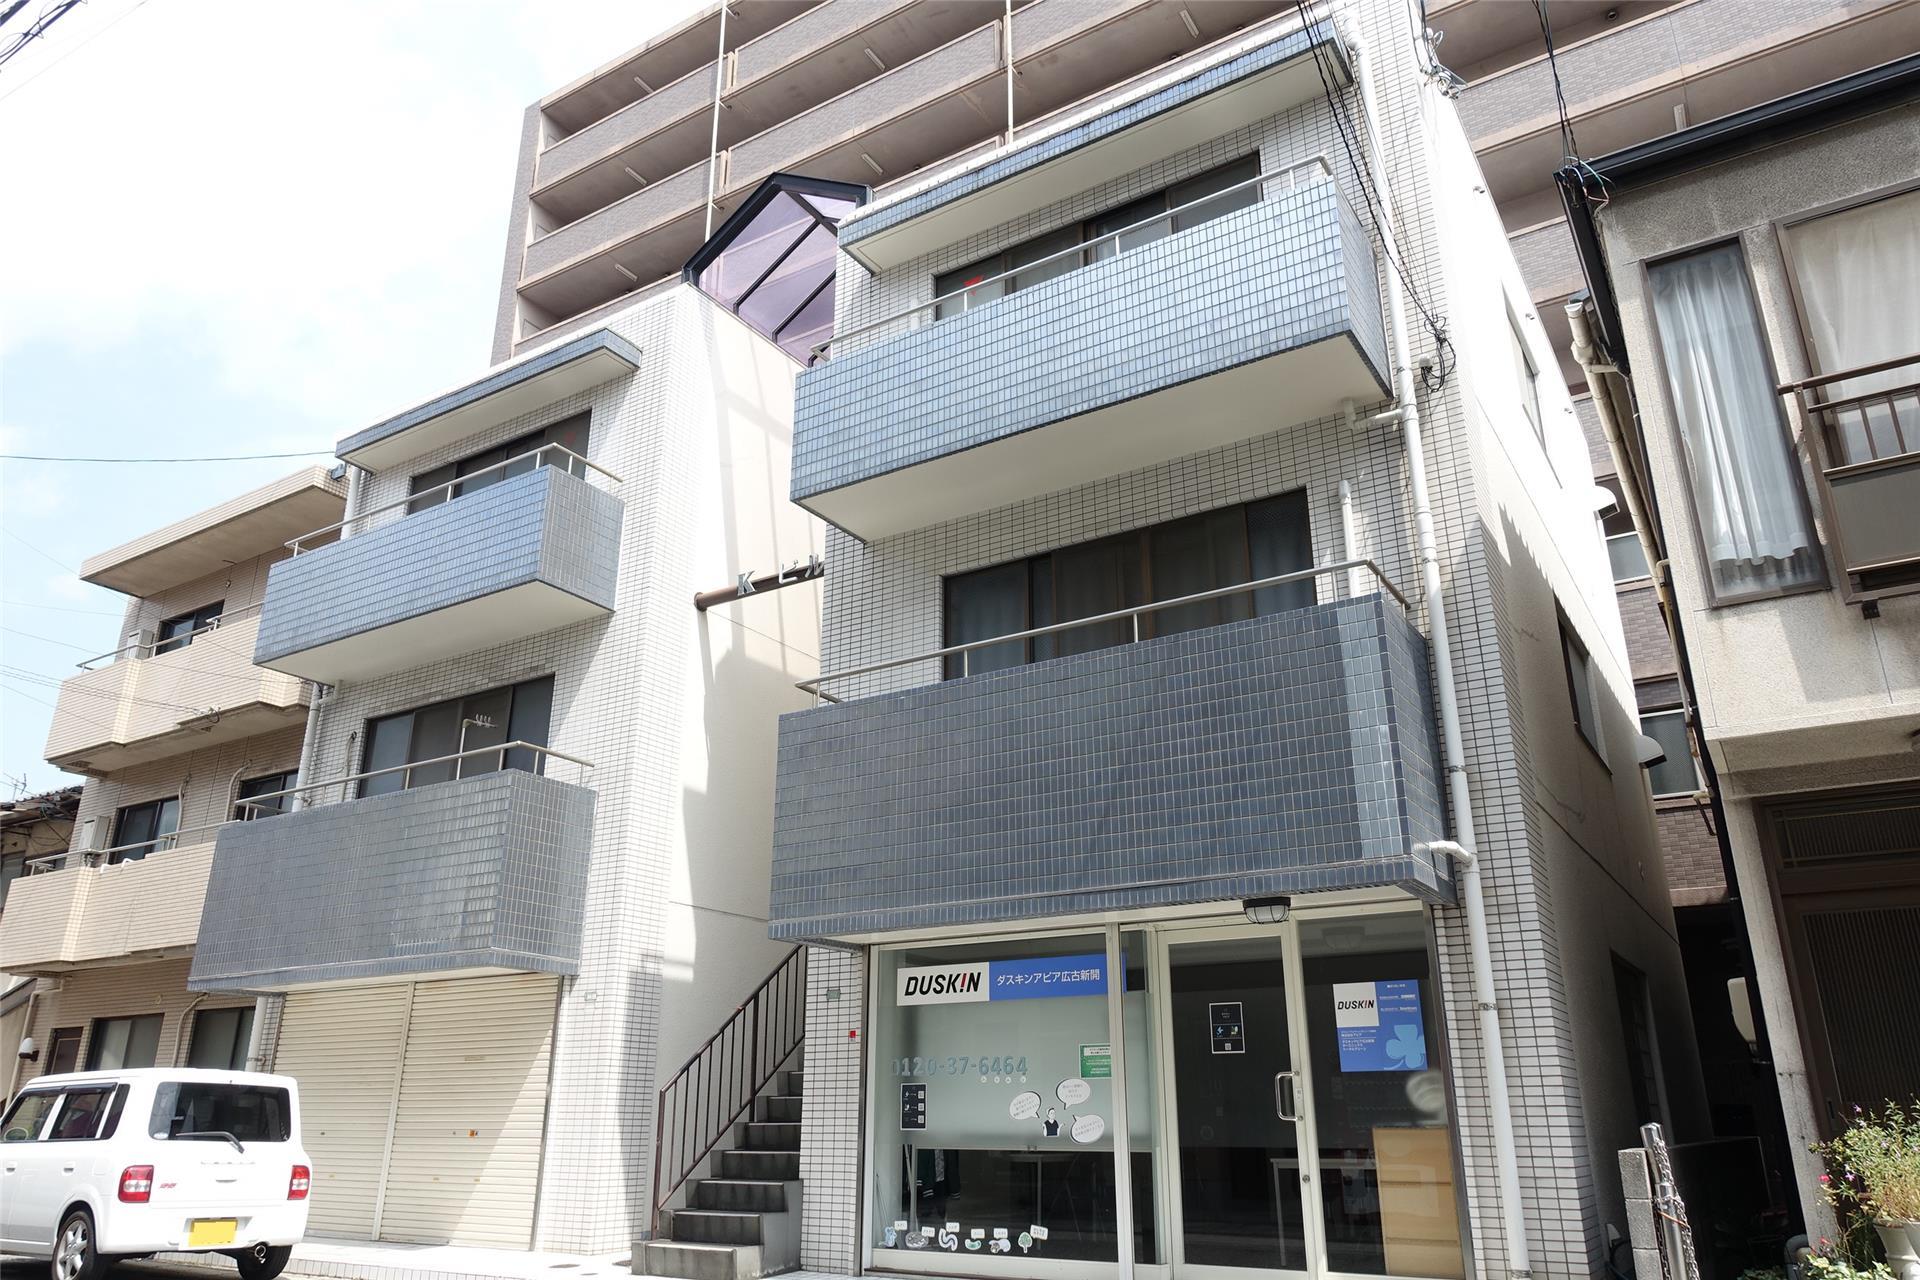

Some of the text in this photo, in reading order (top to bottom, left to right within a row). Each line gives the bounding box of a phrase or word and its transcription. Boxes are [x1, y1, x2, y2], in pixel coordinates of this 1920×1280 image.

[997, 968, 1100, 986] ダスキンアピア広古新開
